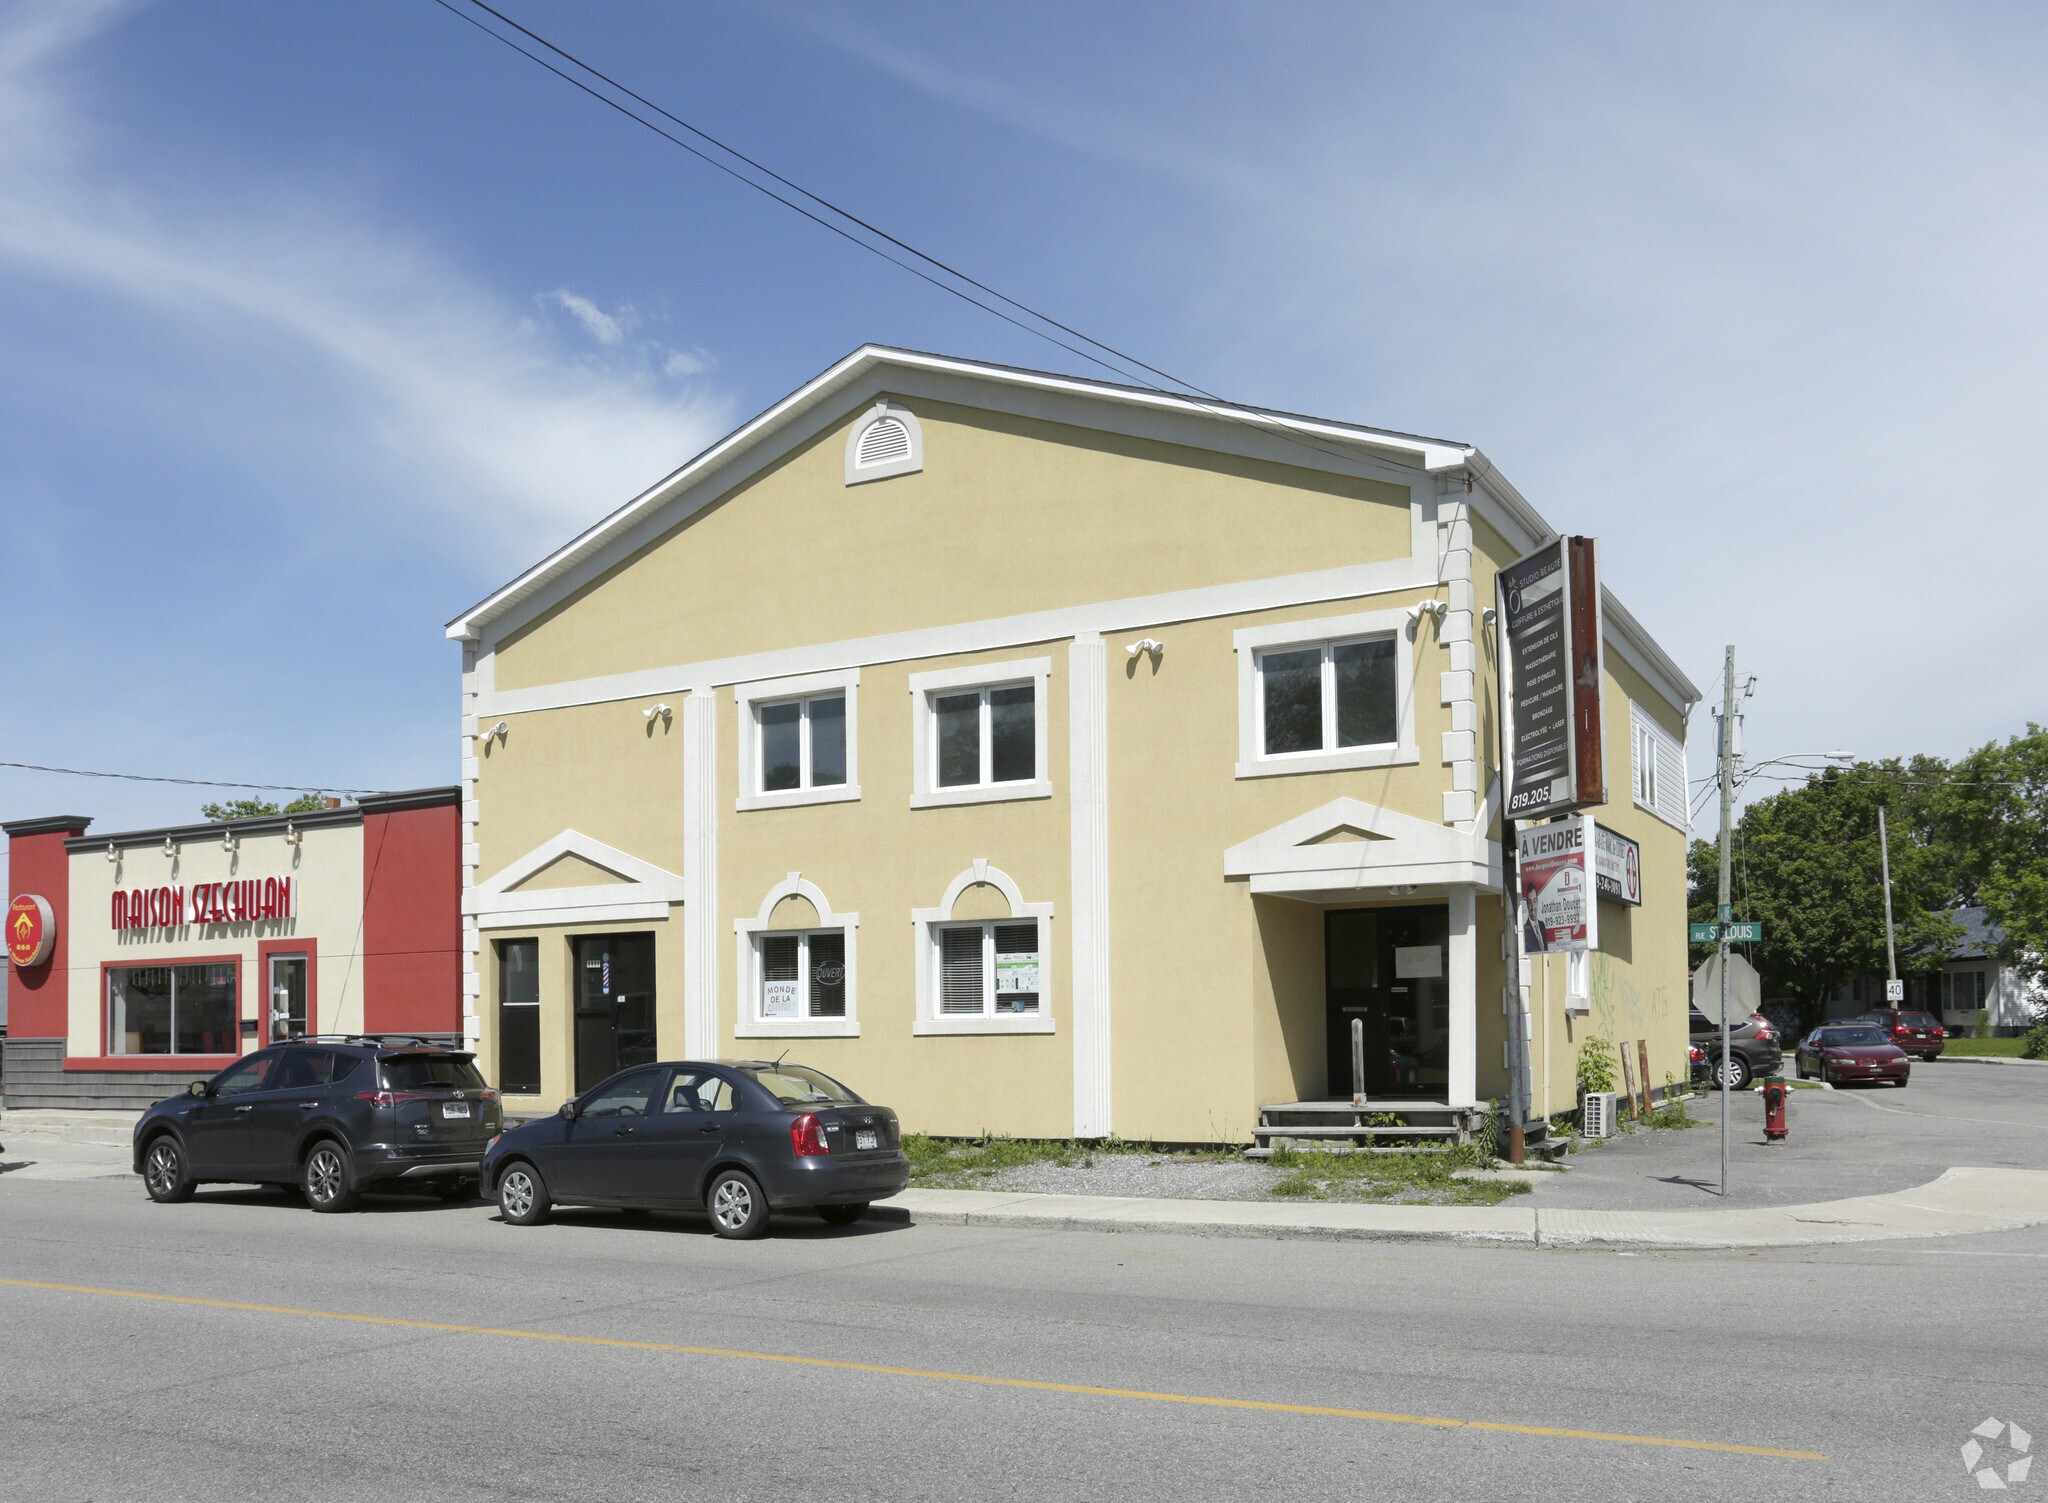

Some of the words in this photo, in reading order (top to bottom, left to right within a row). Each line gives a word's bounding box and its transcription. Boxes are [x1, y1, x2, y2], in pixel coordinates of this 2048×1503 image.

[1520, 571, 1540, 587] STUDIO
[1512, 611, 1534, 628] COIFFURE
[1522, 640, 1544, 655] EXTENSION
[1543, 636, 1550, 644] DE
[1549, 631, 1559, 641] CILS
[1526, 677, 1538, 688] POSE
[1542, 683, 1564, 699] MANUCURE
[1531, 705, 1553, 721] BRONZAGE
[1552, 719, 1565, 730] LASER
[1516, 751, 1543, 767] FORMATIONS
[1521, 835, 1529, 858] À
[1532, 828, 1583, 855] VENDRE
[112, 885, 184, 930] MAISON
[192, 876, 291, 924] SZECHUAN
[1541, 900, 1563, 914] Jonathan
[1562, 897, 1581, 911] Doucet
[1695, 932, 1706, 940] RUE
[817, 967, 844, 978] OUVERT
[767, 985, 797, 995] MONDE
[1888, 985, 1901, 995] 40
[770, 996, 780, 1004] DE
[782, 995, 791, 1003] LA
